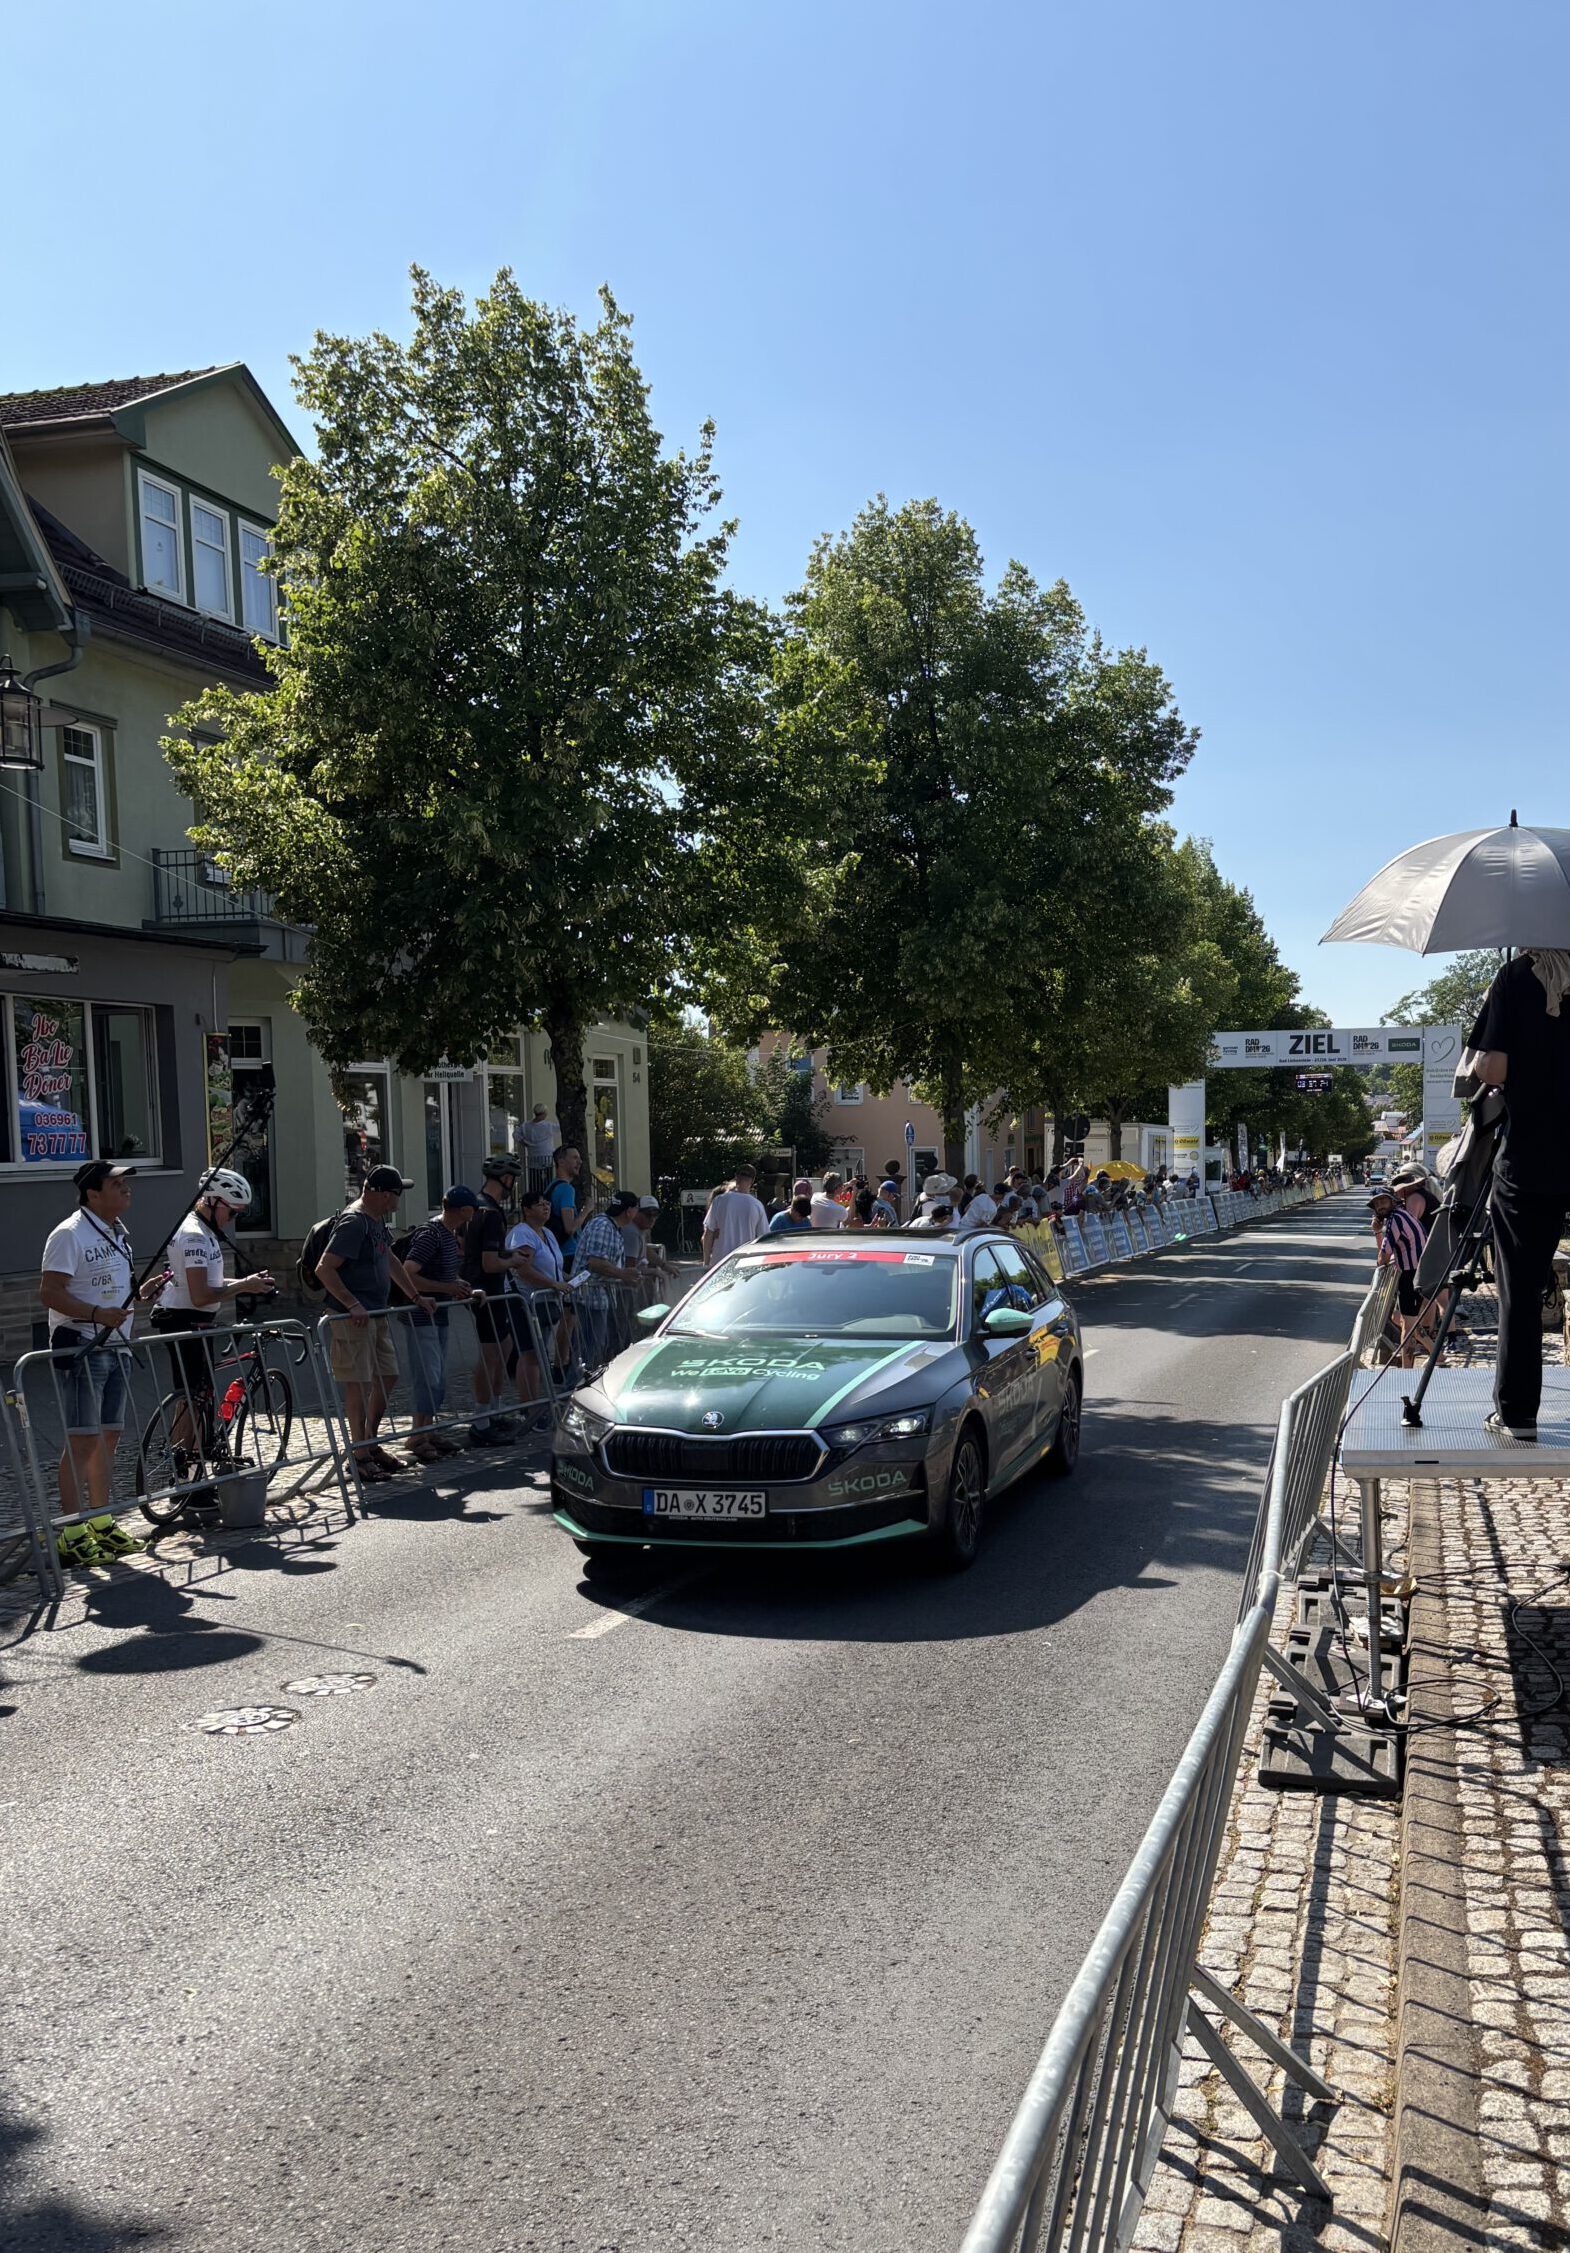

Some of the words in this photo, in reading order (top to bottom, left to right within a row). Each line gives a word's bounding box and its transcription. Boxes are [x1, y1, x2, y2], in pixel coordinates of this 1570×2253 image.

[1289, 1034, 1340, 1054] ZIEL
[35, 1113, 78, 1127] 036961
[671, 1369, 700, 1377] We
[656, 1492, 681, 1513] DA
[695, 1493, 707, 1514] X
[712, 1494, 762, 1515] 3745
